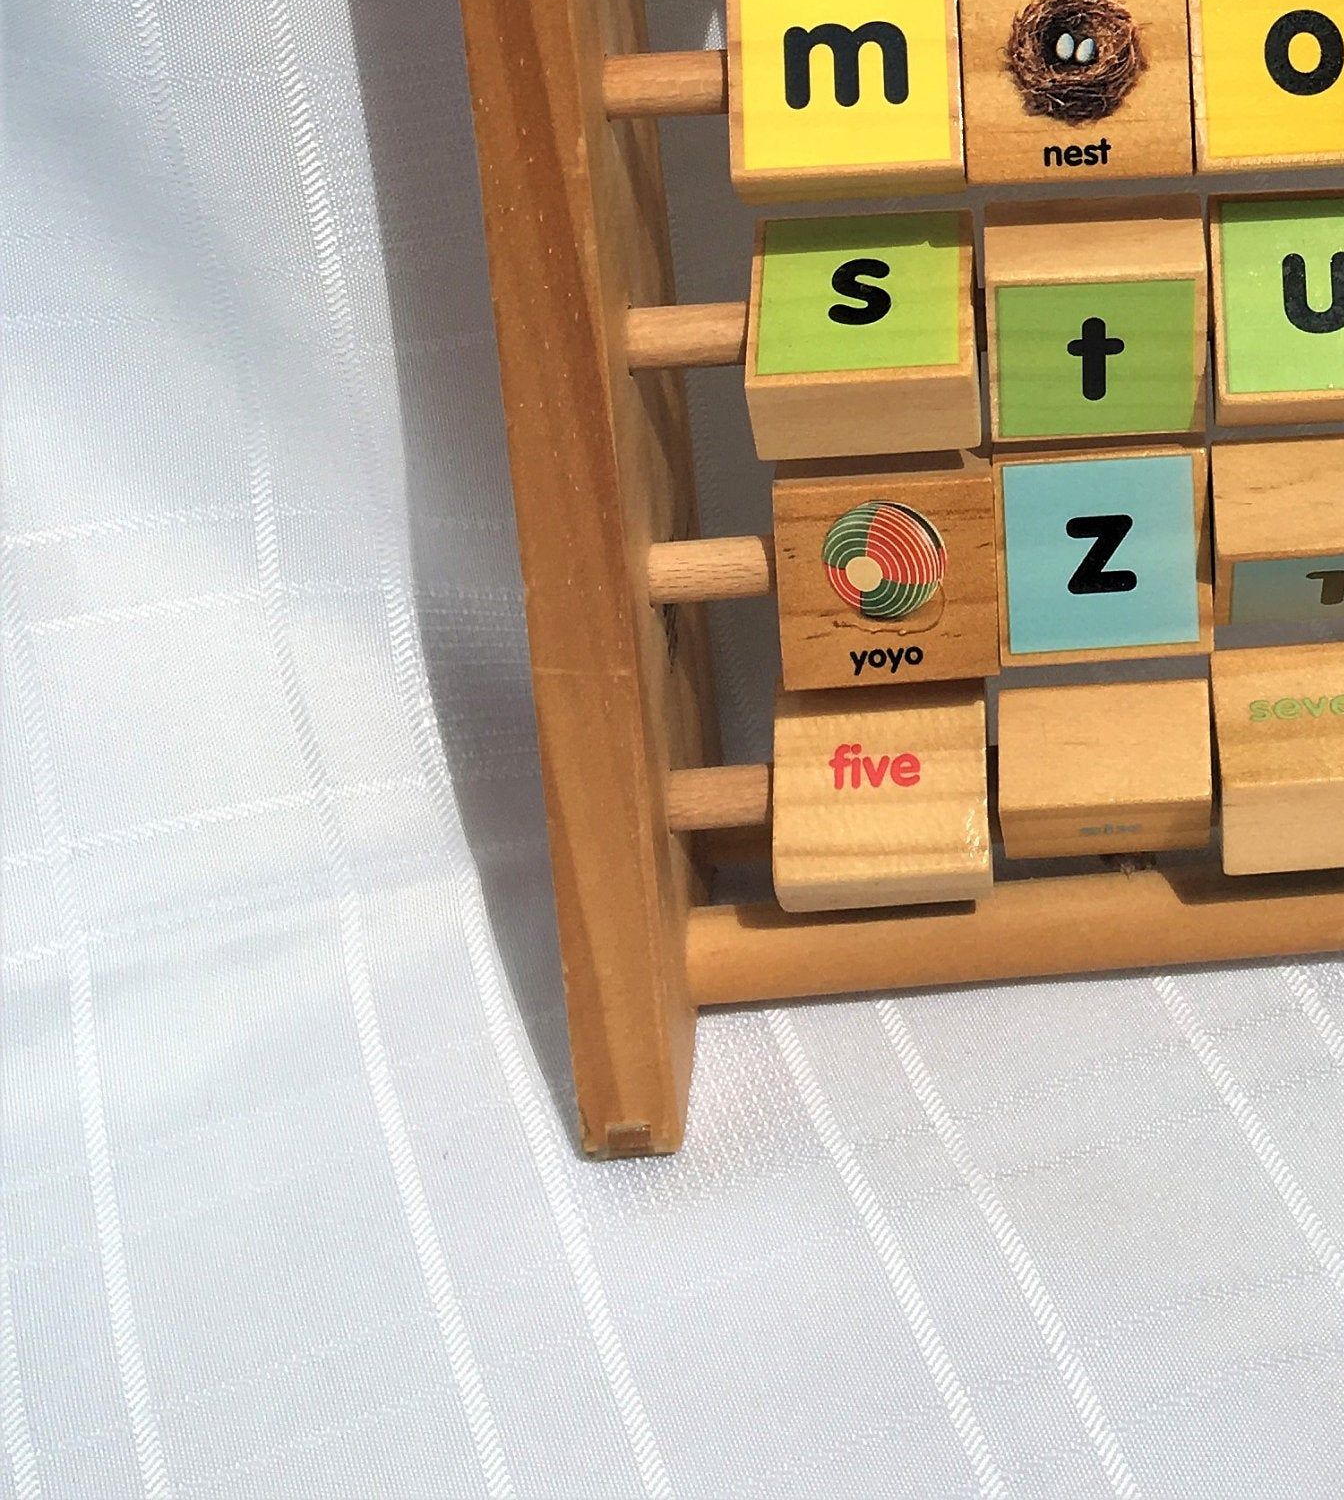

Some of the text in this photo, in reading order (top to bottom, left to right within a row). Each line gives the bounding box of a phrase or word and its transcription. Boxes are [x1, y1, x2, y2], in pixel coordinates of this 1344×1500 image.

[783, 21, 909, 110] m
[1264, 9, 1344, 95] o
[1043, 139, 1111, 167] nest
[827, 258, 892, 326] s
[1067, 316, 1125, 401] t
[850, 645, 924, 675] yoyo
[828, 743, 921, 790] five
